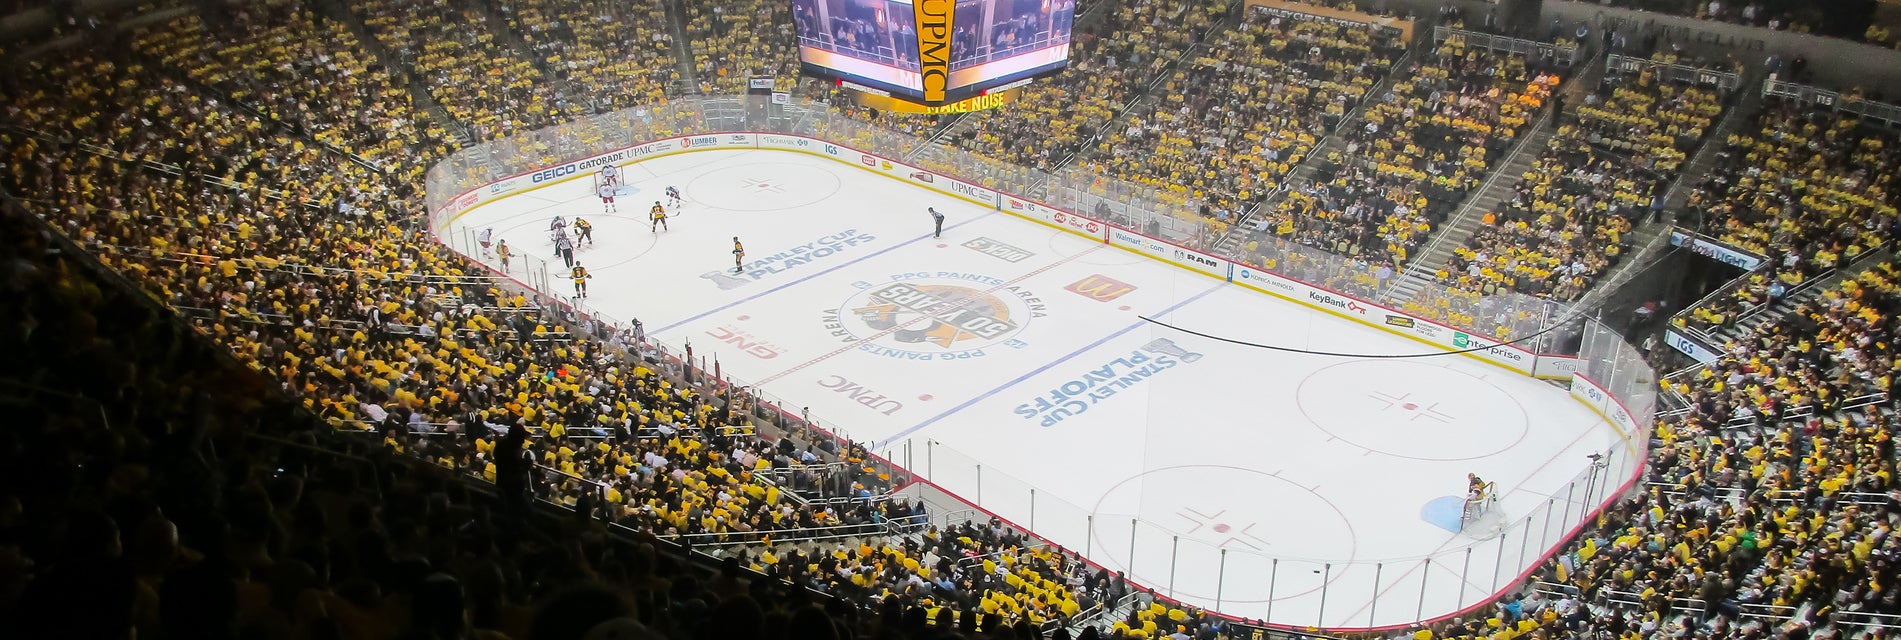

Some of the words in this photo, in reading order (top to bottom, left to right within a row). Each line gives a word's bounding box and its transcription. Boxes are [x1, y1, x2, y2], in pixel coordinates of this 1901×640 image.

[921, 0, 947, 92] UPMC
[971, 92, 1004, 111] NOISE
[626, 143, 655, 159] UPMC
[691, 136, 717, 147] LUMBER
[824, 144, 838, 156] IGS
[579, 152, 623, 170] GATORADE
[532, 164, 576, 183] GEICO
[951, 181, 978, 198] UPMC
[817, 229, 856, 246] CUP
[1115, 232, 1141, 246] Walmart
[748, 233, 876, 281] PLAYOFFS
[1187, 253, 1217, 268] RAM
[890, 271, 930, 281] PPG
[936, 271, 1004, 285] PAINTS
[1007, 285, 1047, 318] ARENA
[1309, 291, 1346, 308] KeyBank
[822, 308, 859, 343] ARENA
[705, 327, 778, 359] GNC
[858, 343, 933, 361] PAINTS
[1453, 331, 1521, 361] enterprise
[1676, 337, 1693, 354] IGS
[1013, 350, 1152, 420] PLAYOFFS
[1088, 355, 1177, 404] STANLEY
[816, 374, 904, 417] UPMC
[1040, 400, 1088, 428] CUP
